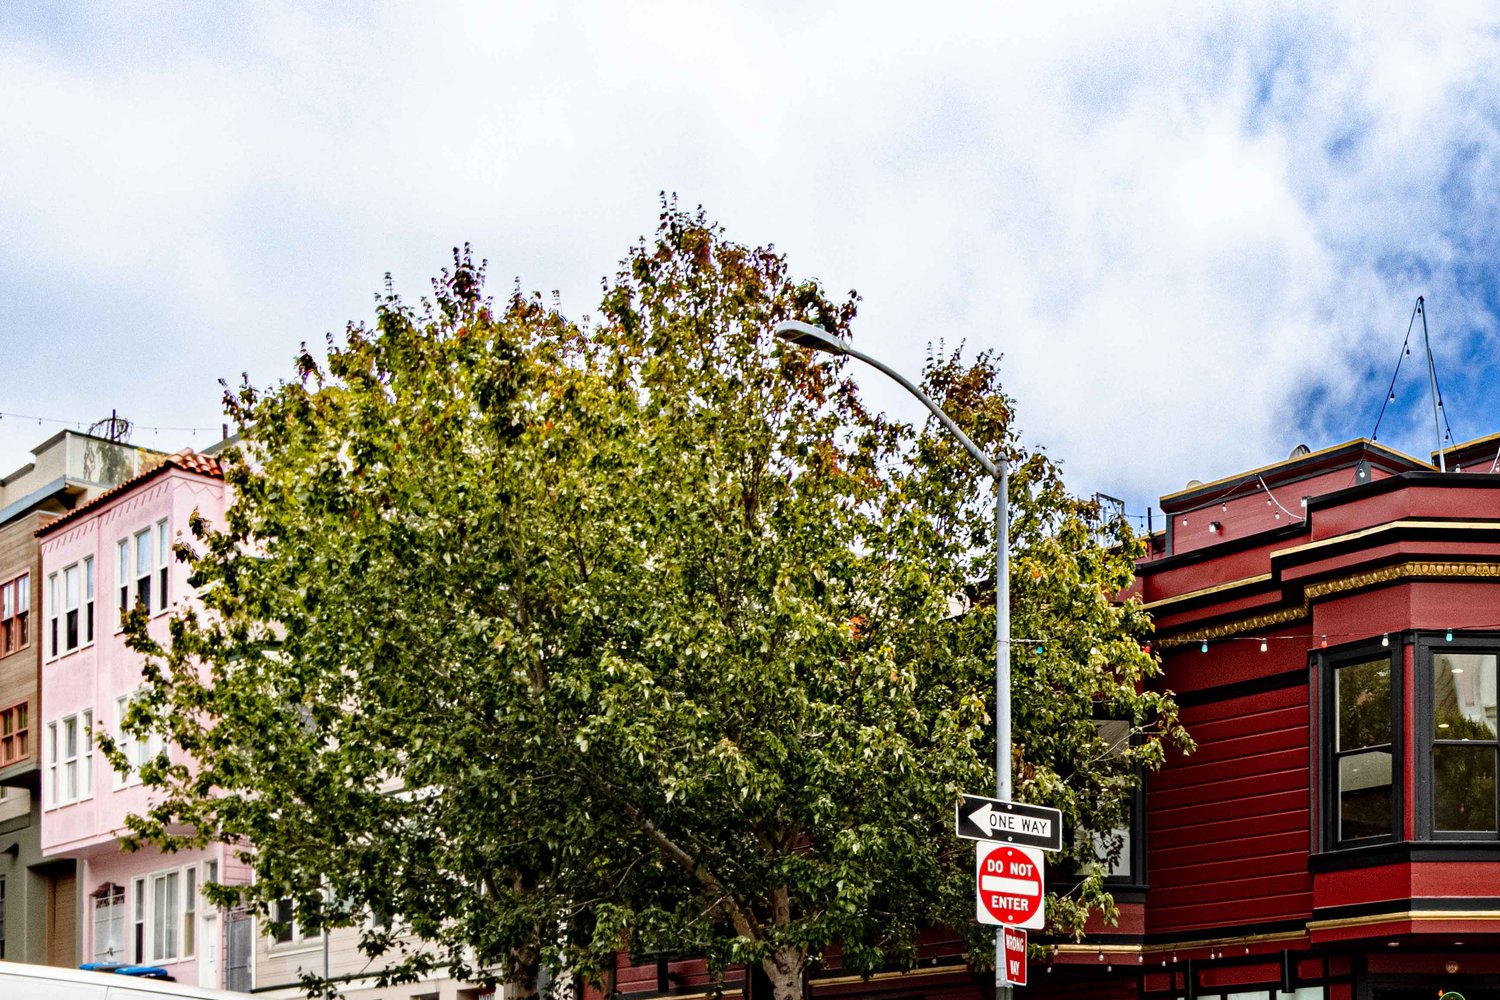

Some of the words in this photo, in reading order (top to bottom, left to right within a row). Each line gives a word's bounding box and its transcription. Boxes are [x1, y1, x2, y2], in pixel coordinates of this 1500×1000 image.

[989, 813, 1015, 830] ONE
[1020, 817, 1048, 835] WAY
[987, 859, 1004, 874] DO
[1010, 860, 1034, 877] NOT
[991, 895, 1029, 912] ENTER
[1005, 934, 1025, 953] WRONG
[1009, 959, 1021, 975] WAY
